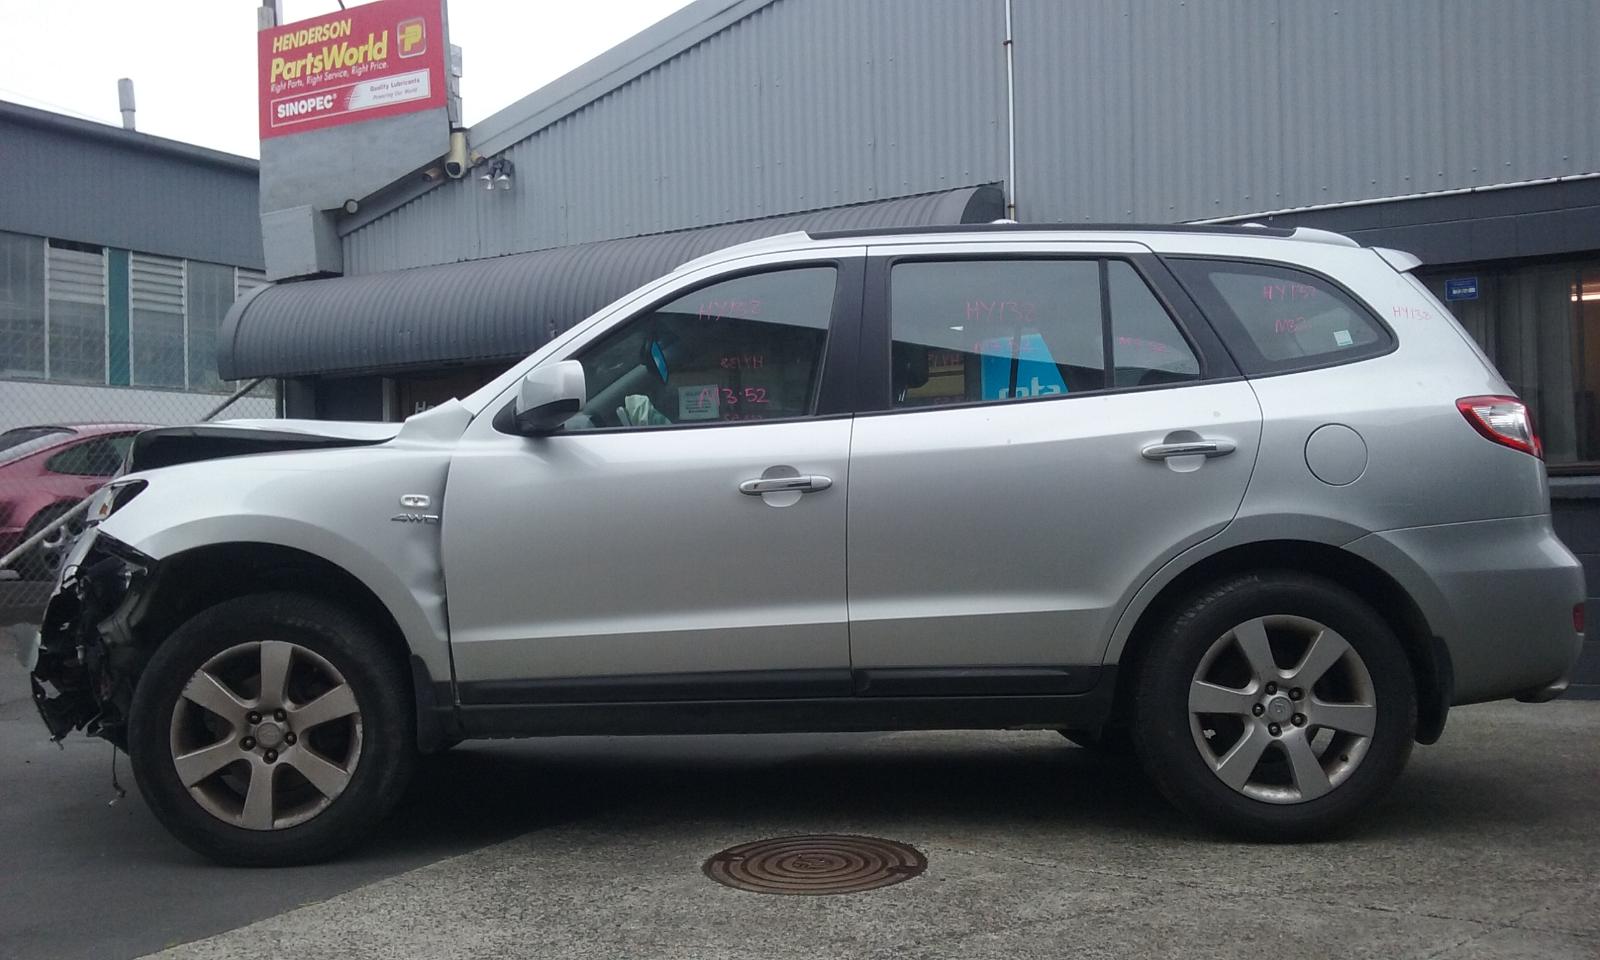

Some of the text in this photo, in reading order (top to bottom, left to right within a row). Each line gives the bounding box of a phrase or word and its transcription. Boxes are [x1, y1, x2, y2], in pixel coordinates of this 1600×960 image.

[272, 18, 352, 53] HENDERSON
[270, 30, 388, 83] PartsWorld
[270, 81, 286, 95] Right
[306, 73, 322, 86] Right
[351, 64, 369, 77] Right
[277, 95, 334, 118] SINOPEC
[391, 513, 439, 524] 4WD
